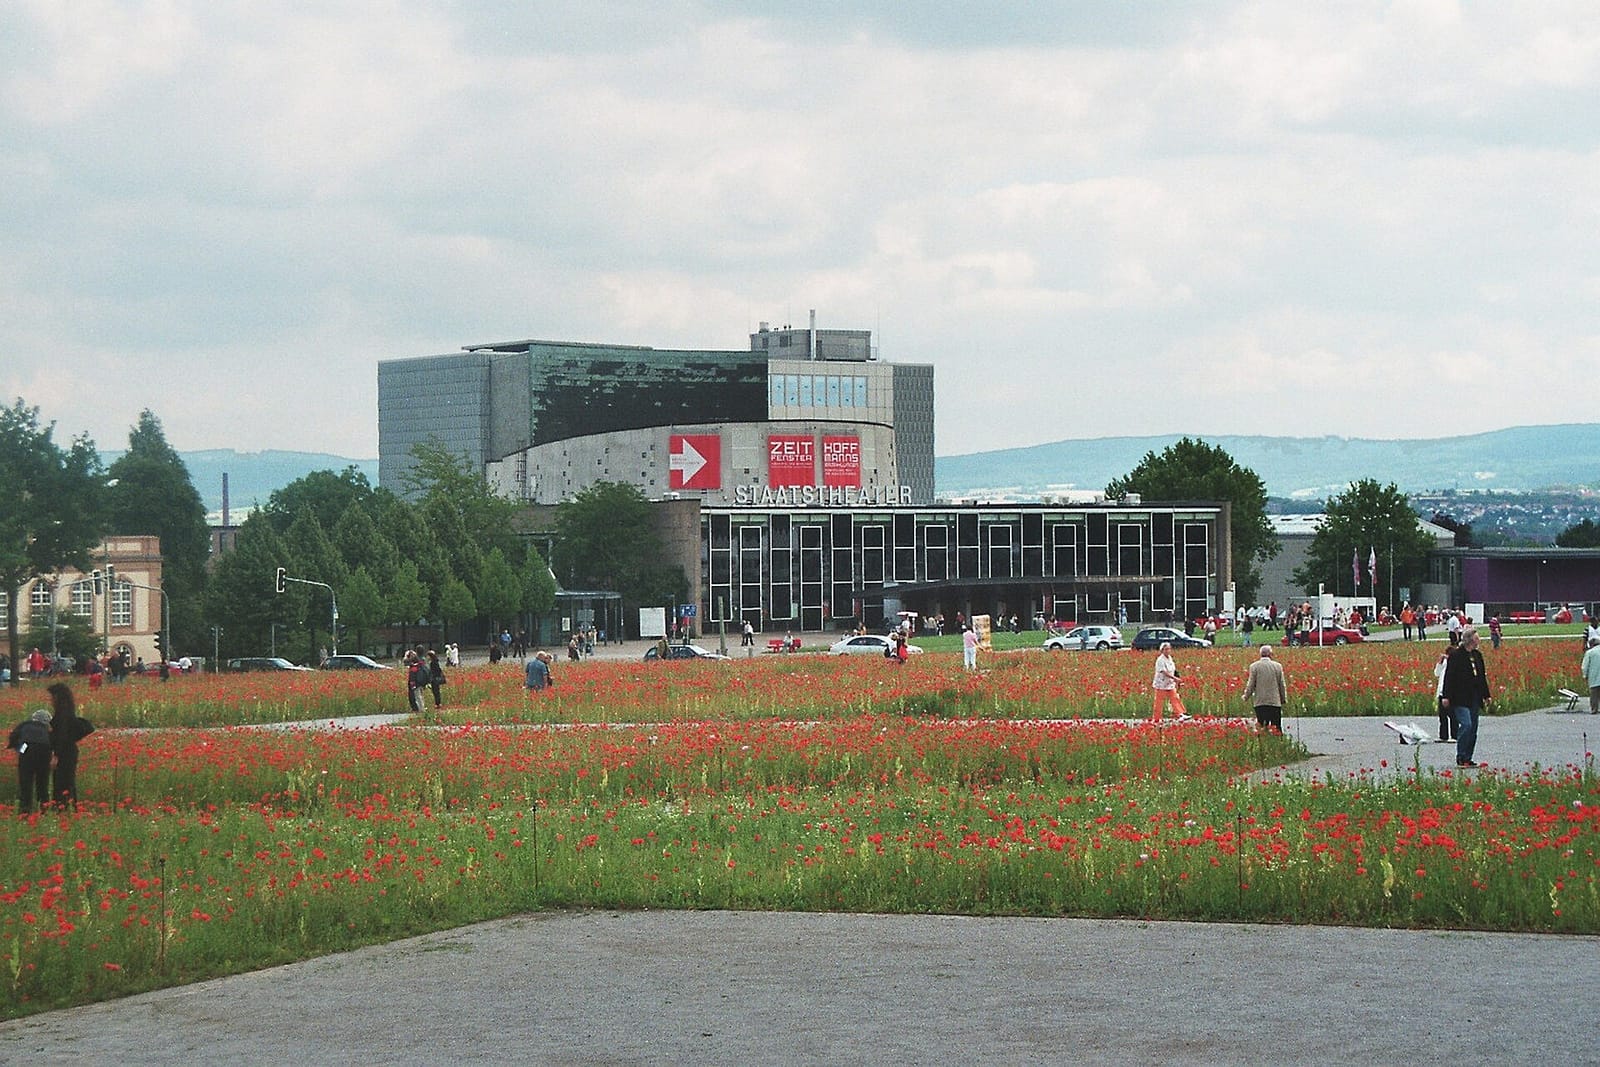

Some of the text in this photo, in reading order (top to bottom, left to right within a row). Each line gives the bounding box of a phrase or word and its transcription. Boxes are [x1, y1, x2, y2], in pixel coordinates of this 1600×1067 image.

[770, 441, 813, 454] ZEIT
[824, 442, 859, 453] HOFF
[770, 454, 812, 462] FENSTER
[735, 485, 912, 504] STAATSTHEATER
